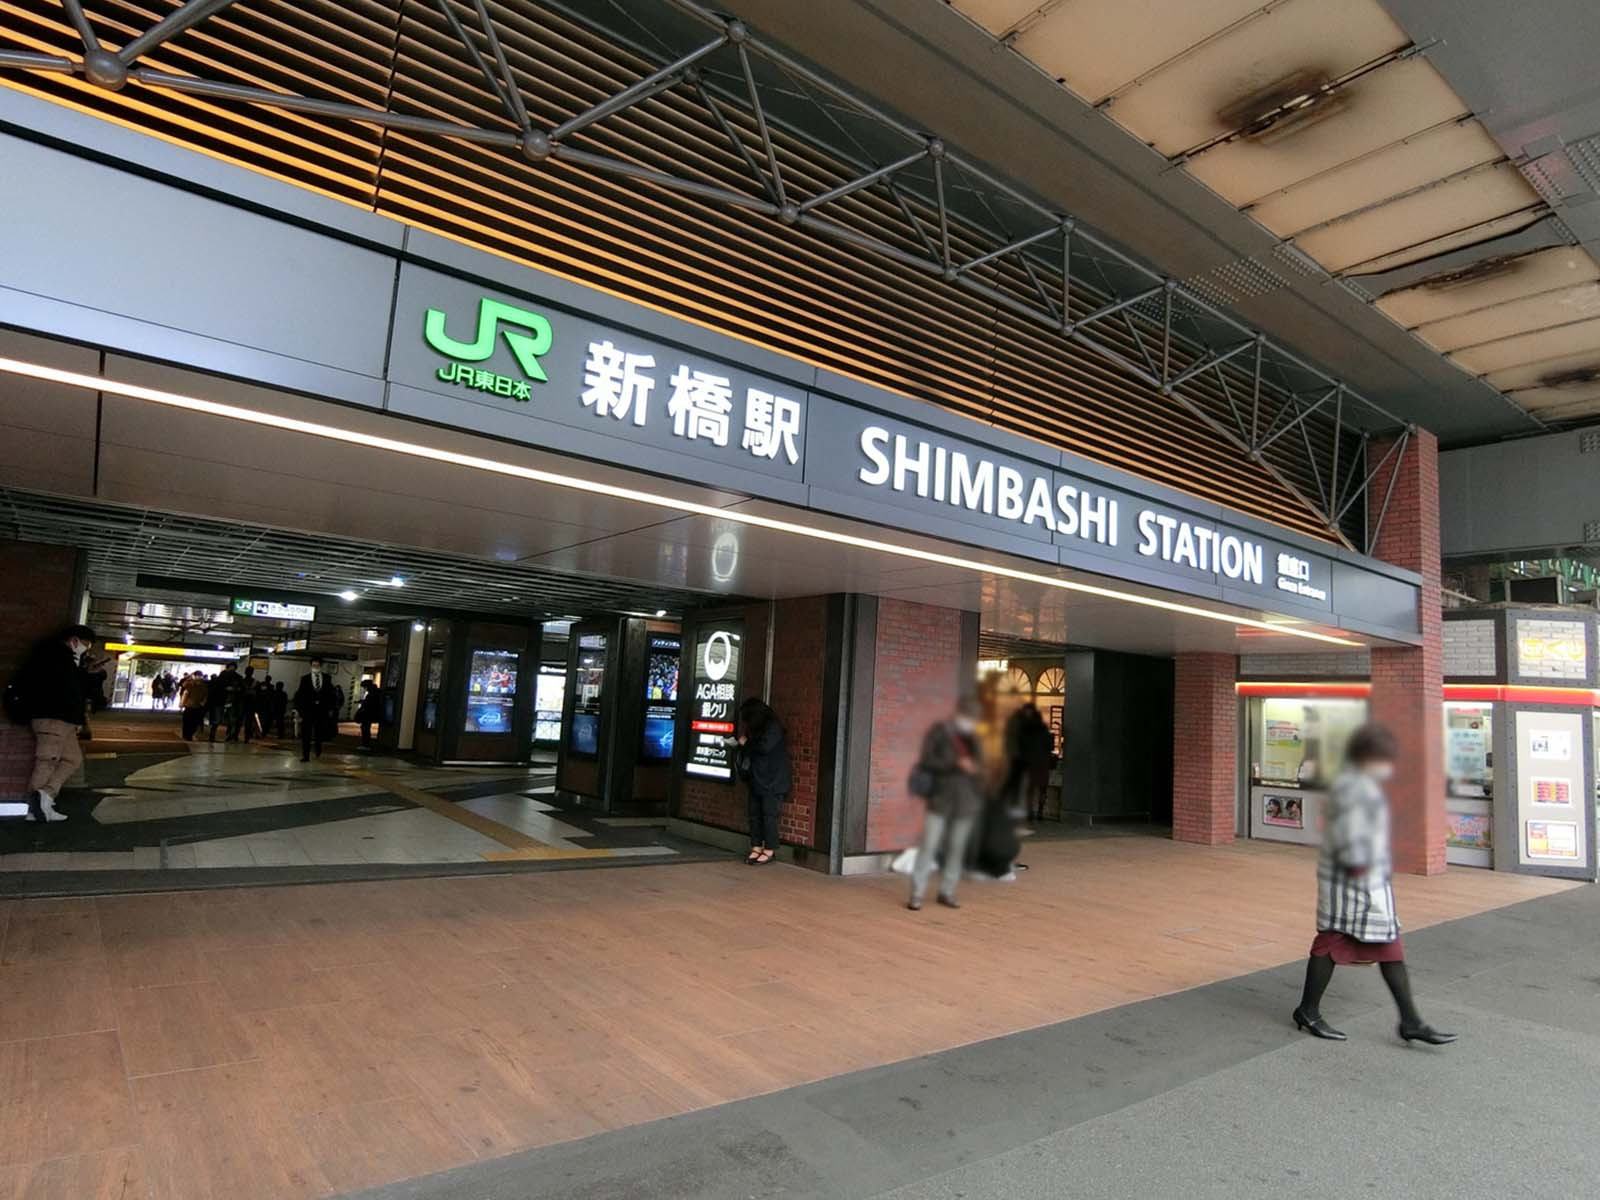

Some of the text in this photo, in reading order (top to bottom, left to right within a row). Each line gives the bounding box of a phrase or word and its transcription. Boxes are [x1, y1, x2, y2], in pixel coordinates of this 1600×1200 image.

[425, 298, 553, 381] JR
[438, 362, 532, 400] JR東日本
[582, 340, 801, 465] 新橋駅
[859, 426, 1263, 585] SHIMBASHI STATION
[696, 683, 735, 701] AGA相談
